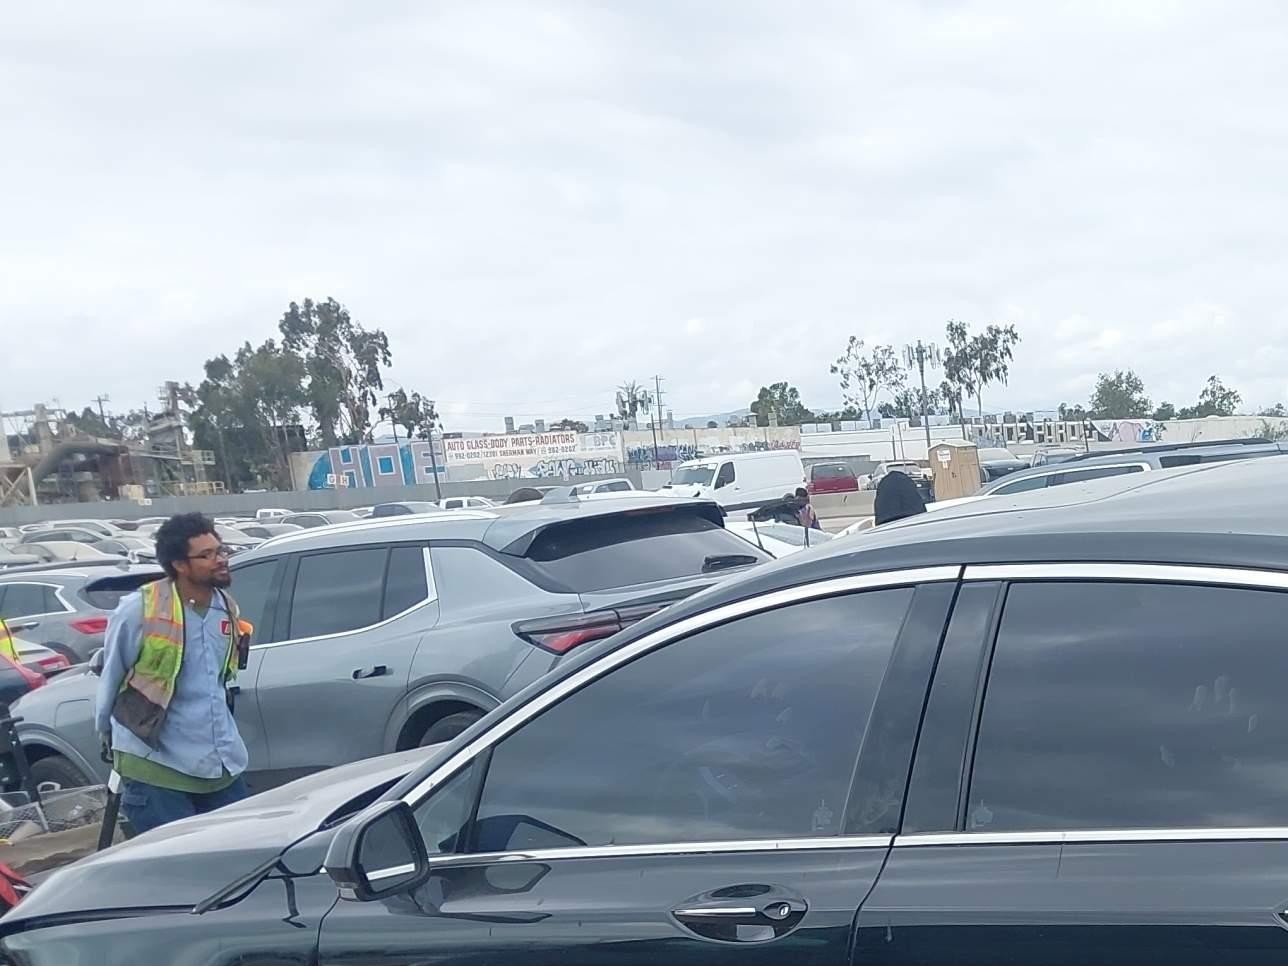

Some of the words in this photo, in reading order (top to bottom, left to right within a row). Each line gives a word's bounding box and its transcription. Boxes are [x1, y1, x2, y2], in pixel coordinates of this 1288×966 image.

[447, 441, 465, 451] AUTO
[511, 433, 576, 447] PARTS-RADIATORS
[499, 448, 525, 456] SHERMAN
[525, 447, 538, 455] WAY
